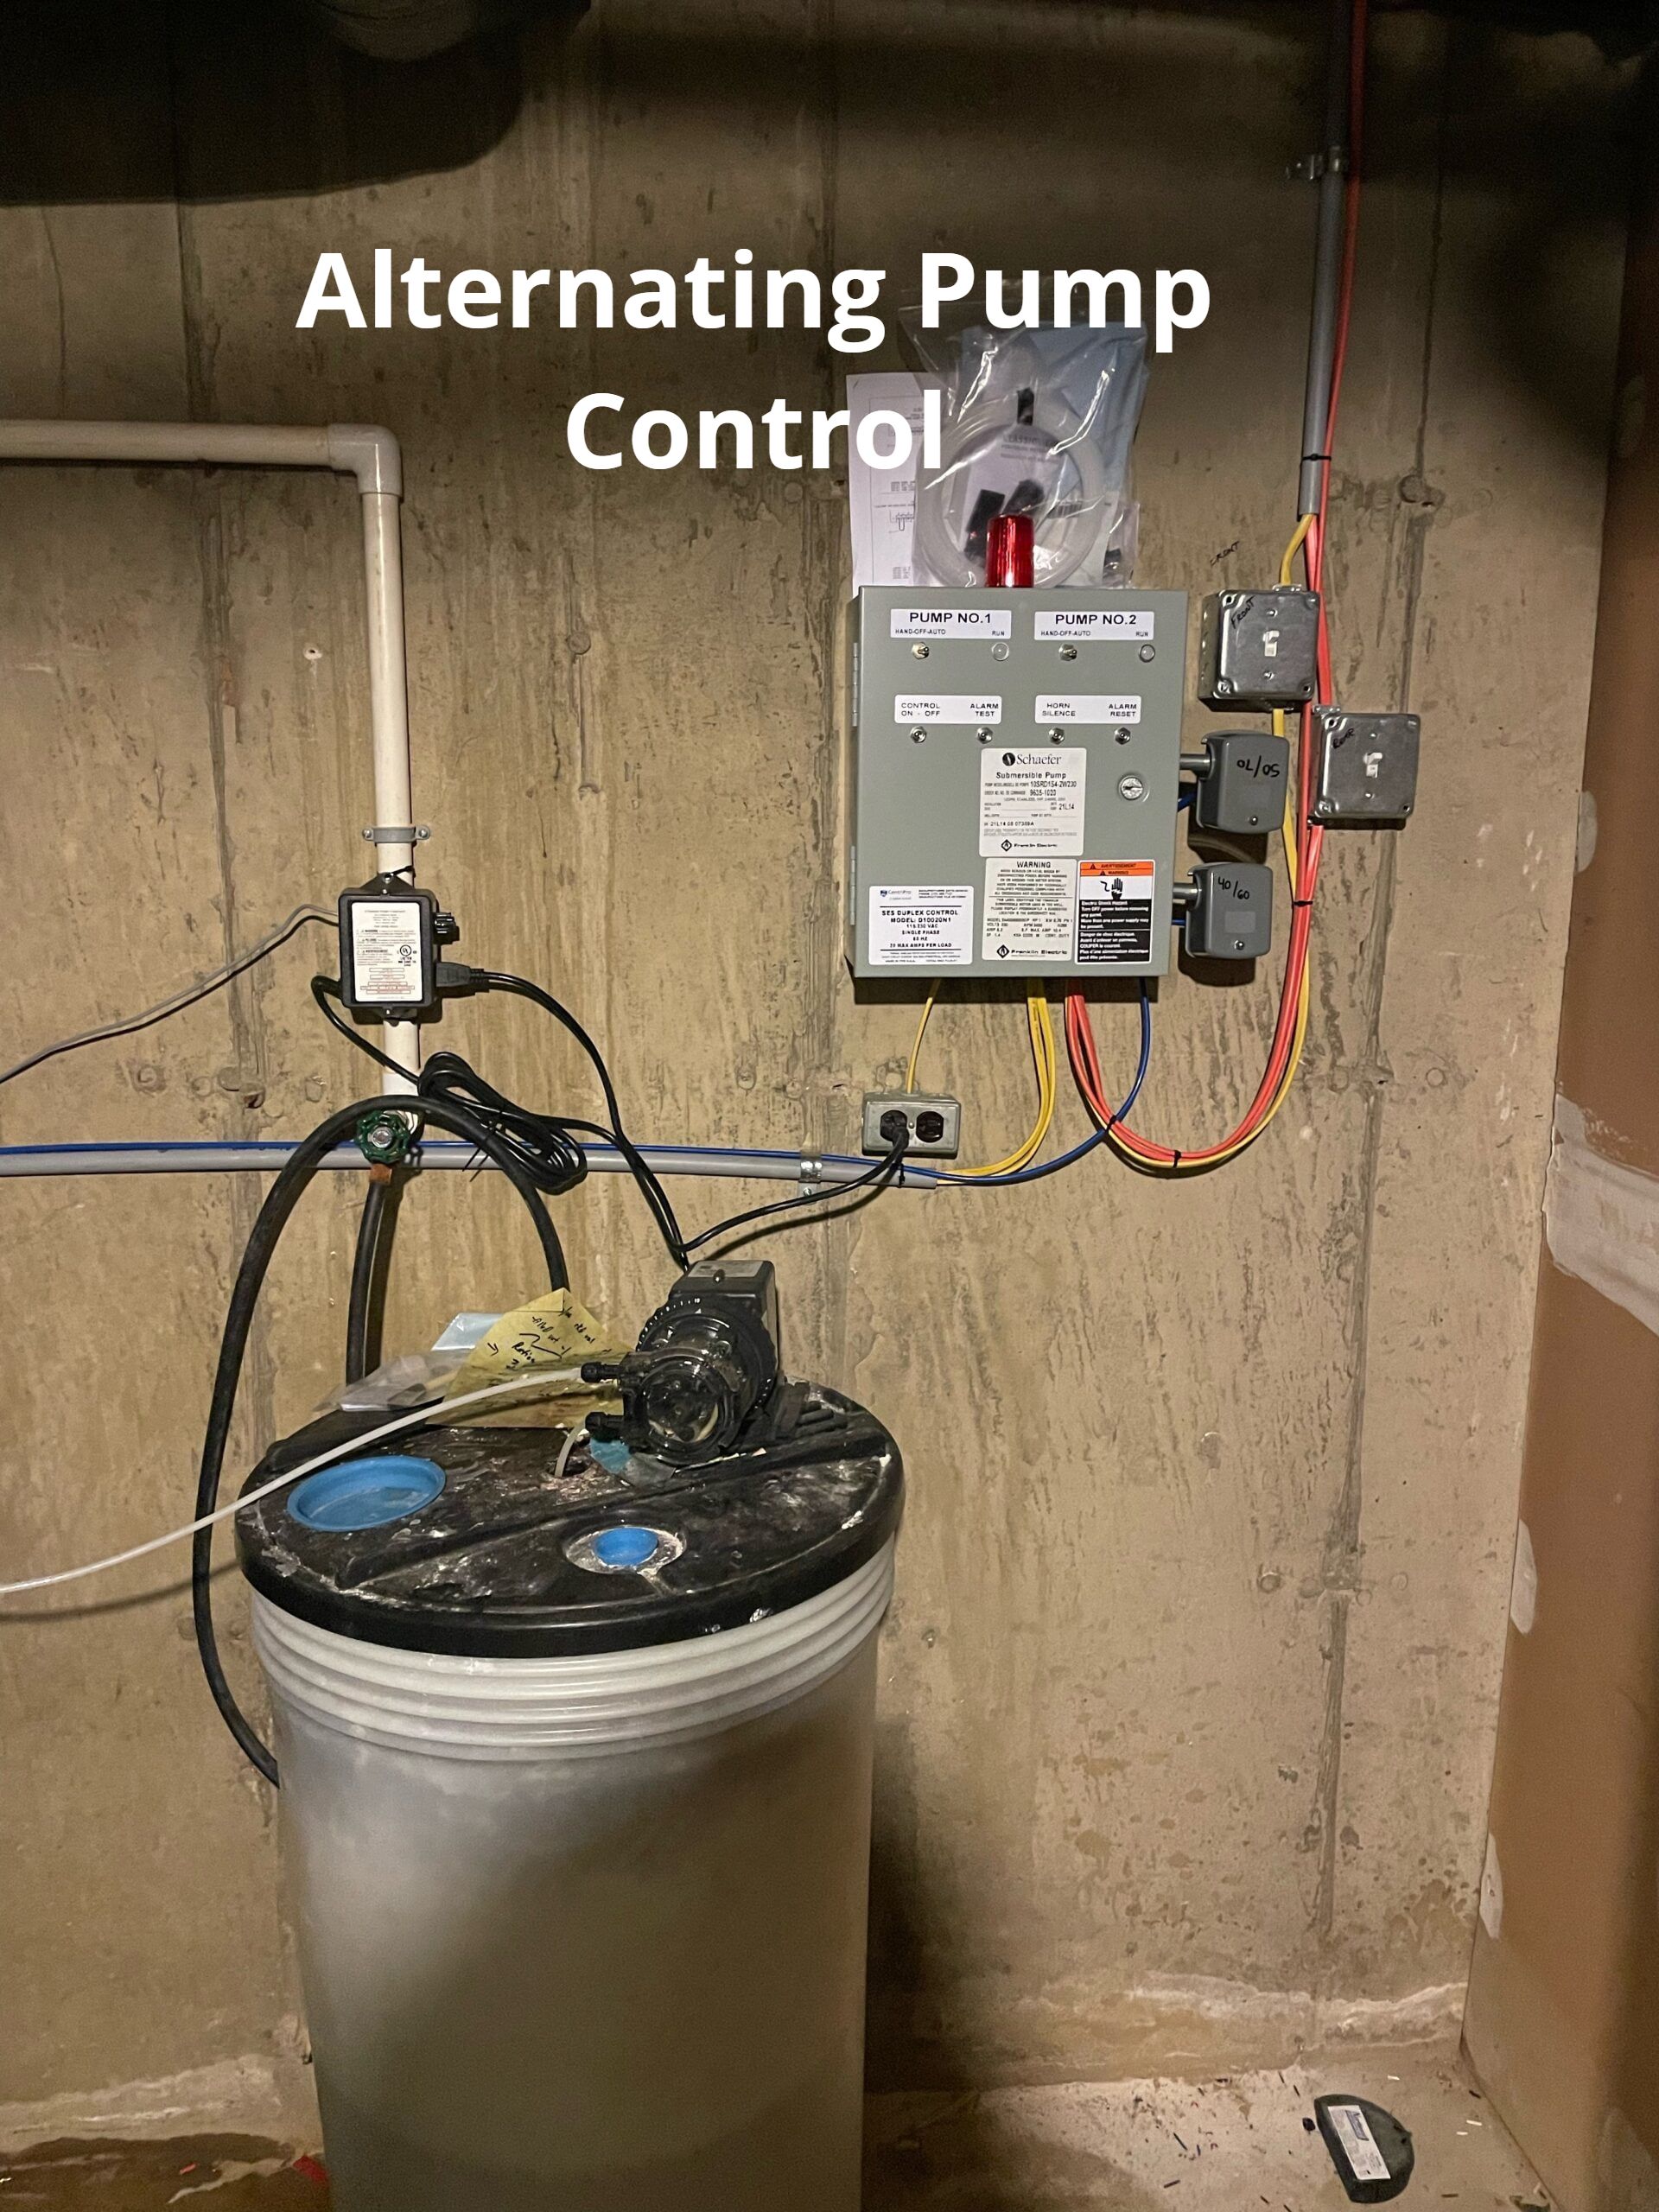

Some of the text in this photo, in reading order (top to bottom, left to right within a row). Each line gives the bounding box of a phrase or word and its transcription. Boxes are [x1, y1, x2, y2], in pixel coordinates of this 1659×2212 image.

[909, 612, 991, 623] PUMP NO.1
[1055, 614, 1137, 625] PUMP NO.2
[1016, 753, 1062, 765] Schaefer
